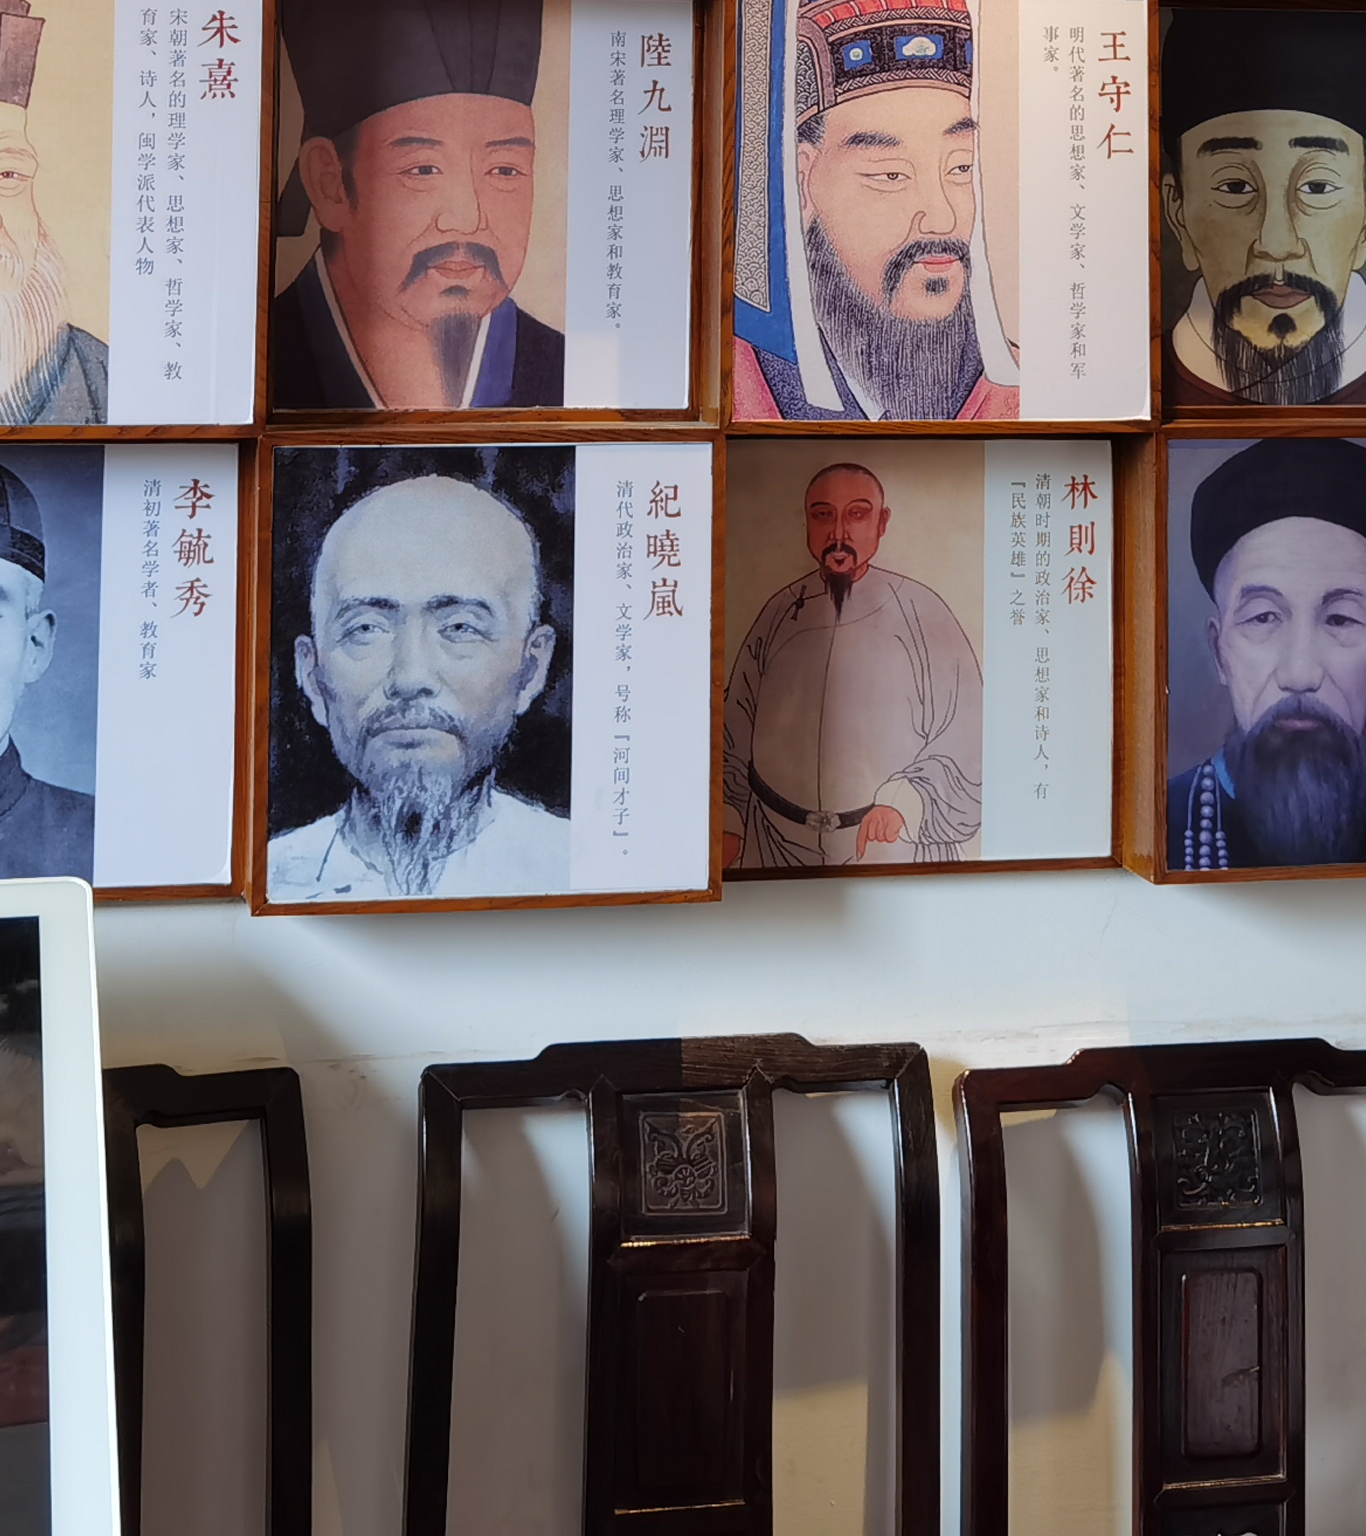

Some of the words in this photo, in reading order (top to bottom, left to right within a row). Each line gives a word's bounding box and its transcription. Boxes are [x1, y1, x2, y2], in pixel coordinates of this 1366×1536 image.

[197, 10, 242, 100] 朱熹
[637, 34, 673, 163] 陸九淵
[1043, 26, 1060, 72] 事家。
[1096, 31, 1134, 159] 王守仁
[138, 479, 162, 680] 清初著名学者、教育家
[169, 478, 215, 619] 李毓秀
[642, 480, 684, 621] 紀曉嵐
[1060, 474, 1098, 605] 林則徐
